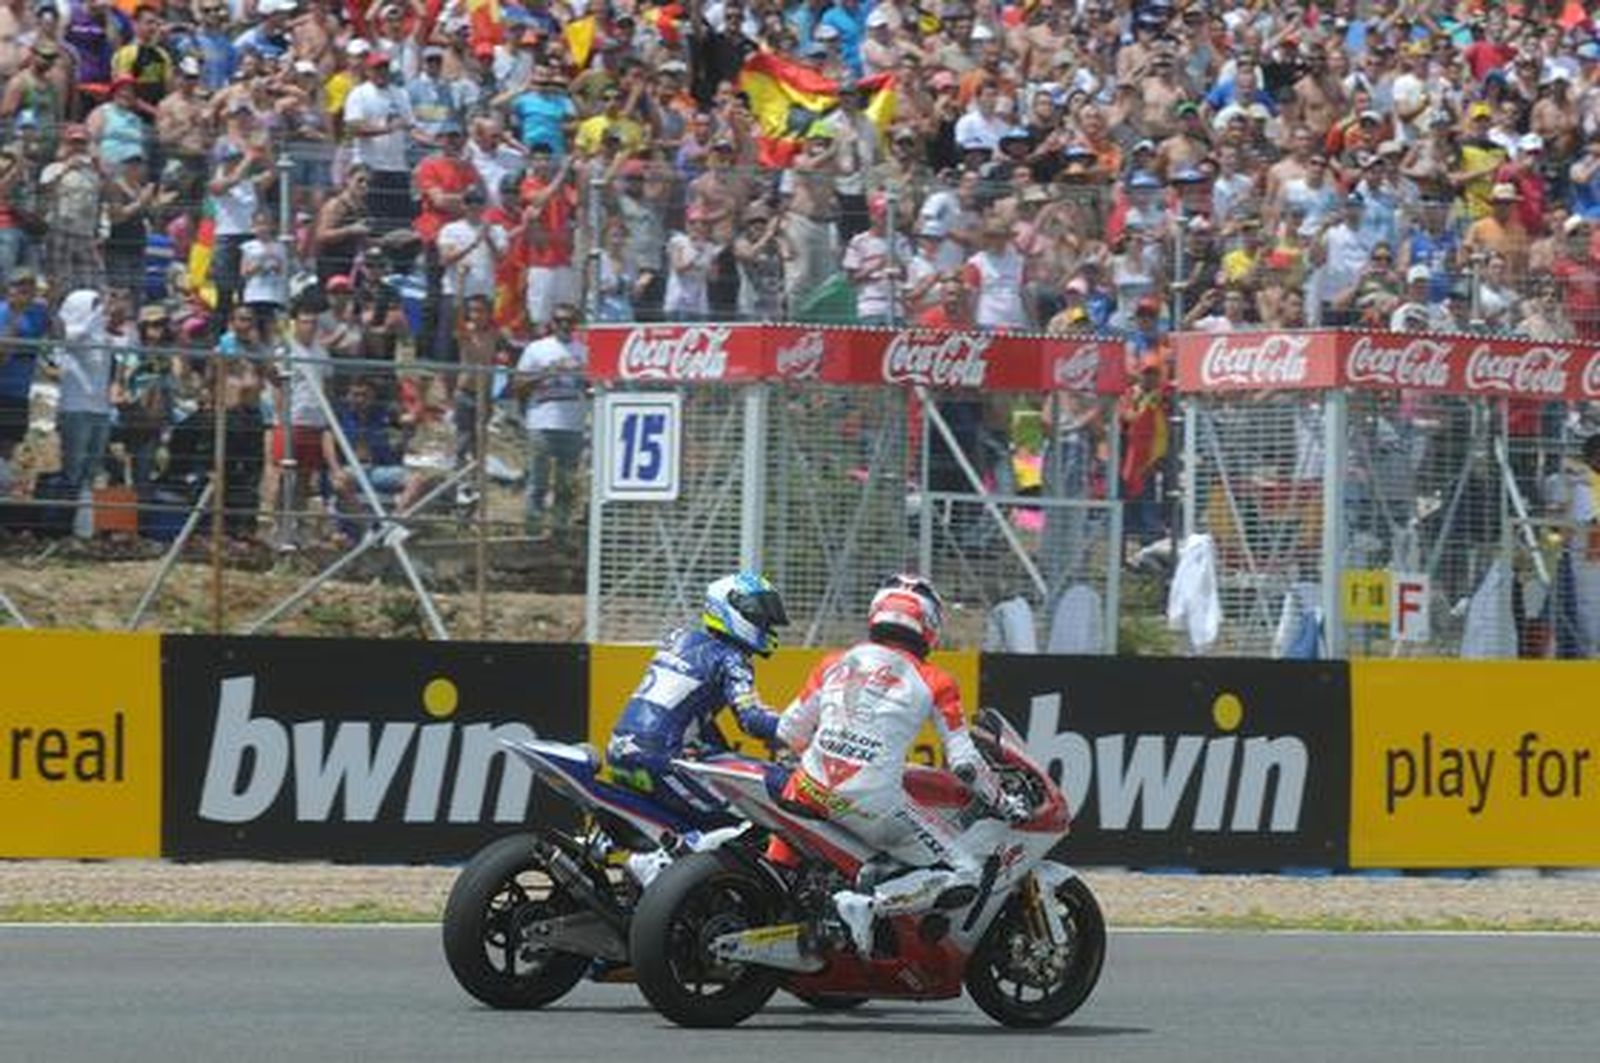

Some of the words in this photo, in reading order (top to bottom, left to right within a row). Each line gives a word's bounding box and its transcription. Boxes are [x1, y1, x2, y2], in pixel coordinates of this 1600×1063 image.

[619, 326, 732, 378] Coca-Cola
[882, 331, 993, 386] Coca-Cola
[1202, 335, 1311, 385] Coca-Cola
[1347, 337, 1453, 386] Coca-Cola
[1465, 344, 1574, 392] Coca-Cola
[620, 414, 665, 480] 15
[1399, 582, 1422, 634] F
[10, 711, 123, 781] real
[199, 675, 536, 823] bwin
[1023, 692, 1309, 832] bwin
[1387, 732, 1495, 814] play
[1515, 732, 1591, 797] for
